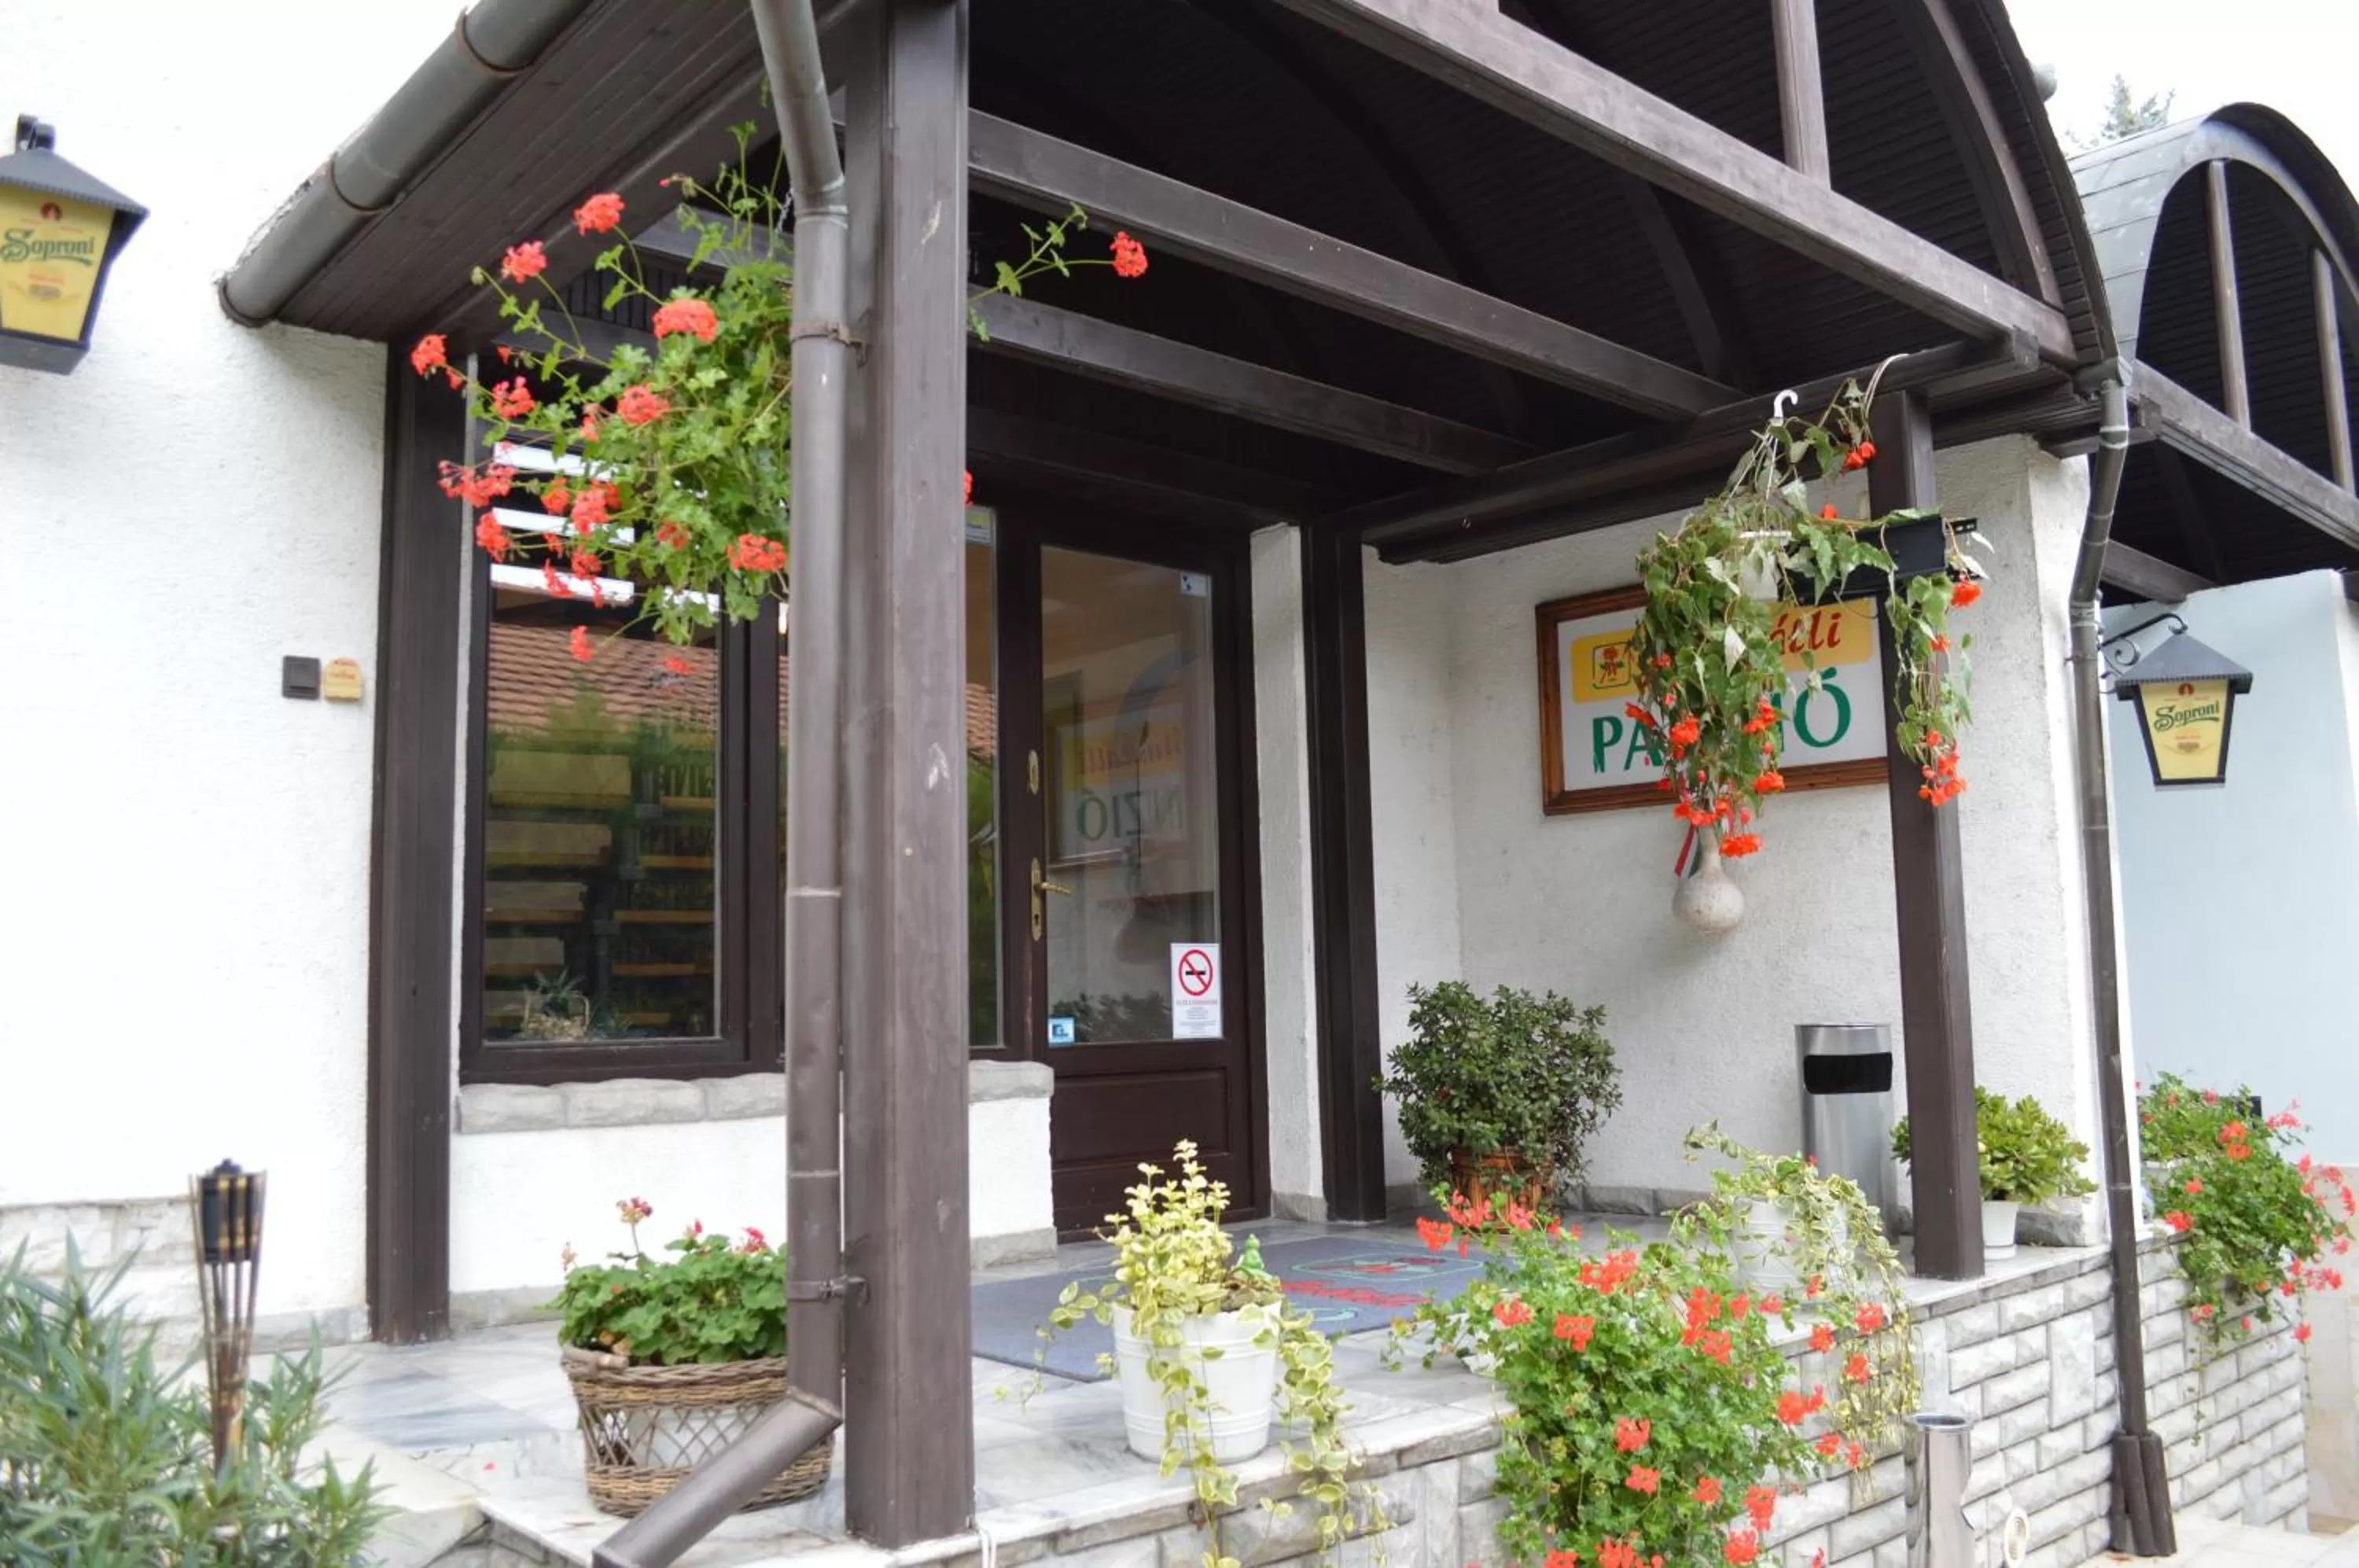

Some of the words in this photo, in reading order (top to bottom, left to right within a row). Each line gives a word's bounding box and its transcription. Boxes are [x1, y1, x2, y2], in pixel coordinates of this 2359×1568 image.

[0, 228, 95, 265] Soproni
[1592, 666, 1852, 774] PAÓ
[2154, 699, 2220, 732] Soproni
